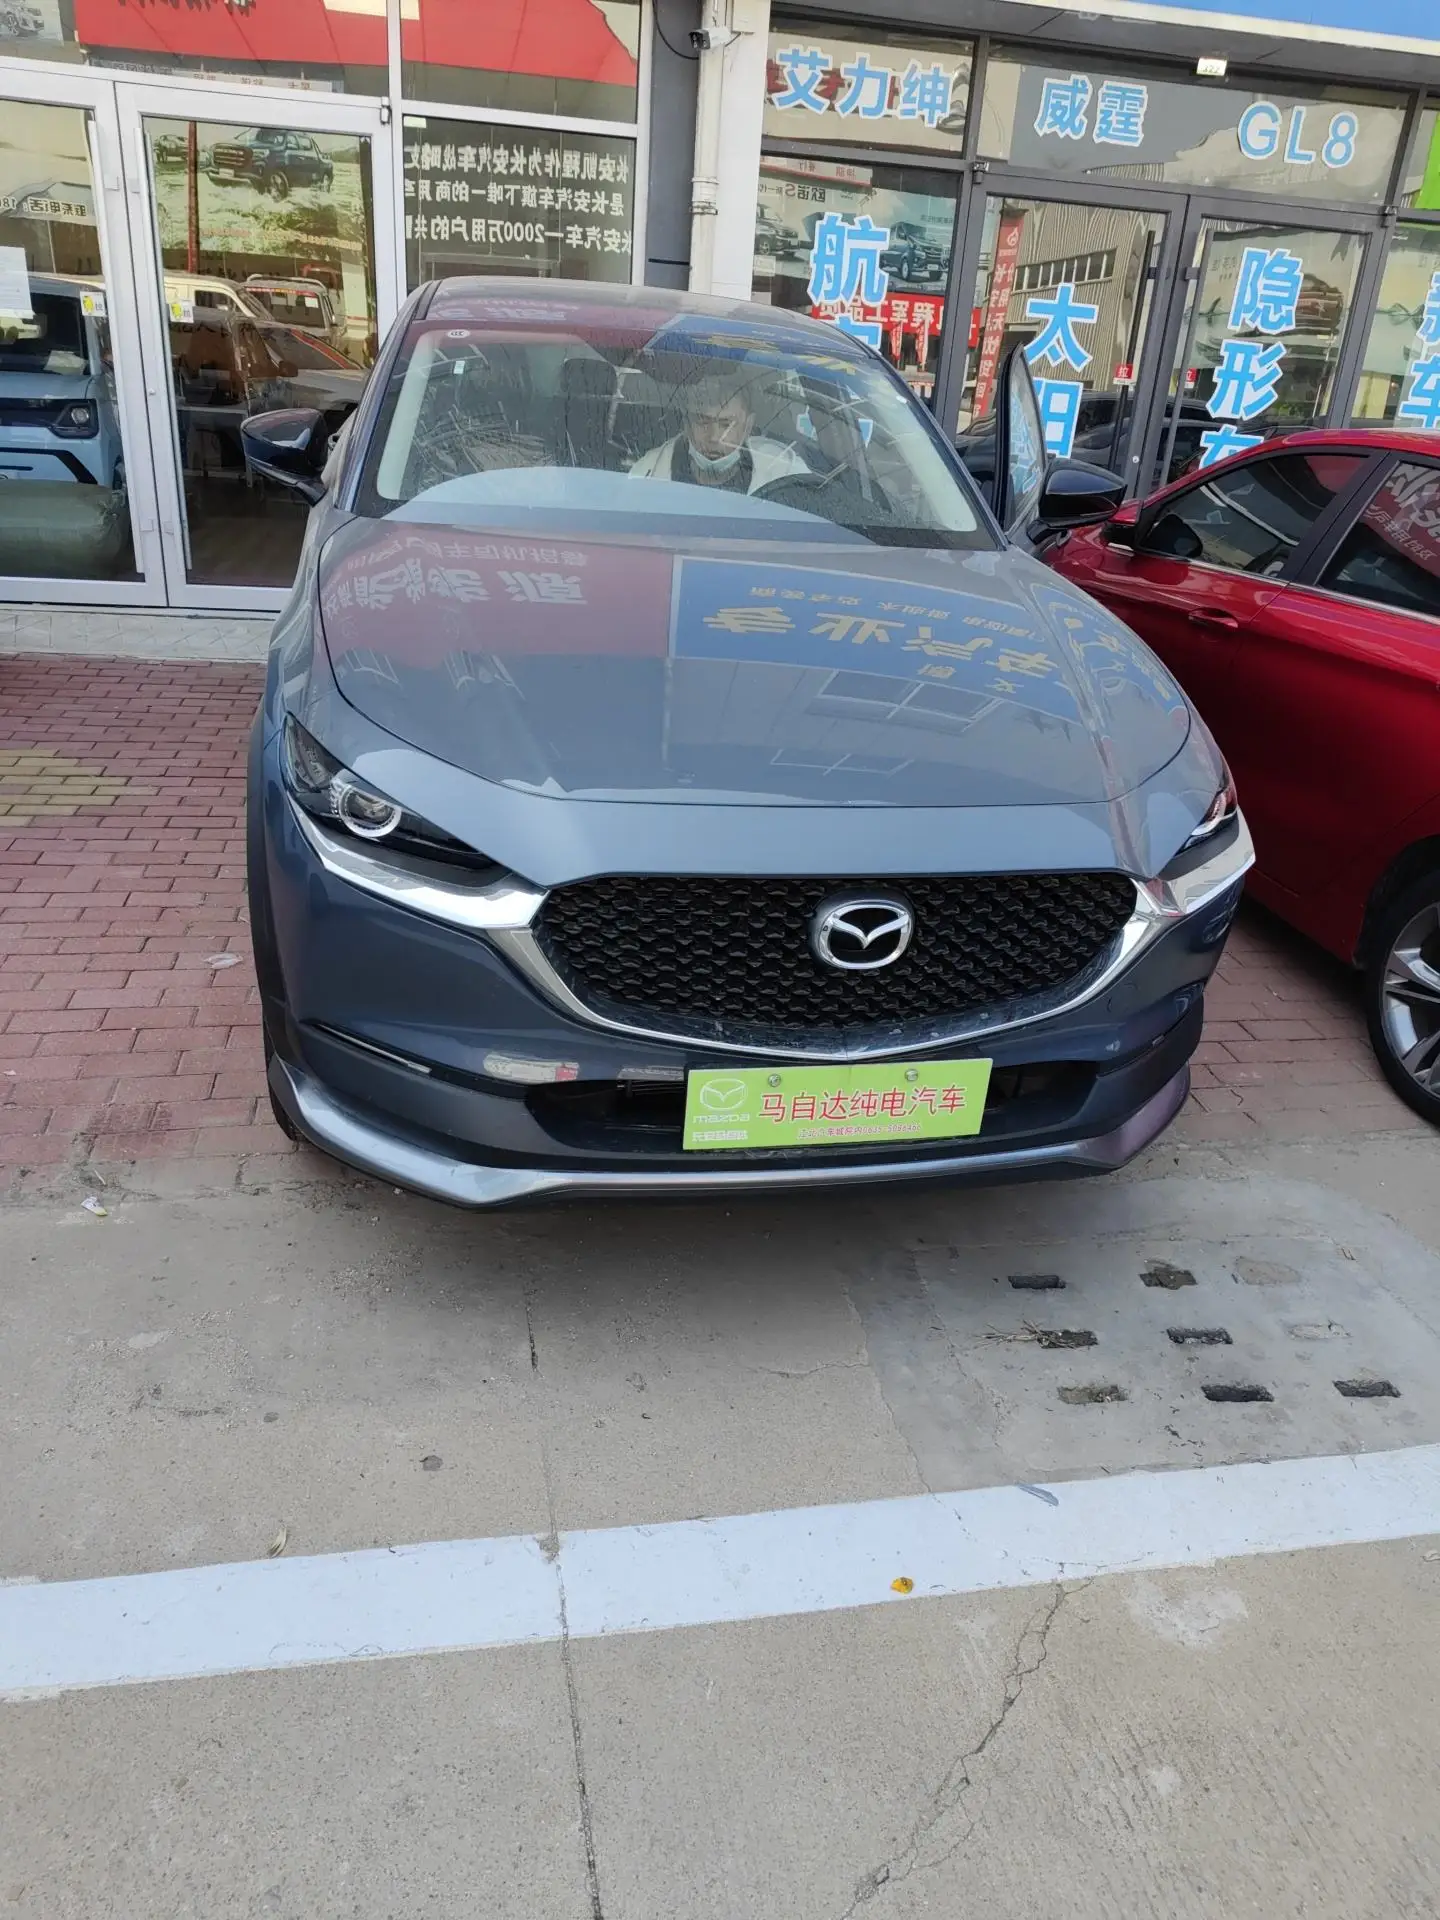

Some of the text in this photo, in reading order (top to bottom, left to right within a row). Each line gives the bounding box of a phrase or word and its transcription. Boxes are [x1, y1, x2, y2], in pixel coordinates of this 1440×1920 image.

[772, 43, 951, 128] 艾力绅
[1034, 74, 1149, 146] 威霆
[1237, 100, 1359, 168] GL8
[759, 1084, 967, 1125] 马自达纯电汽车
